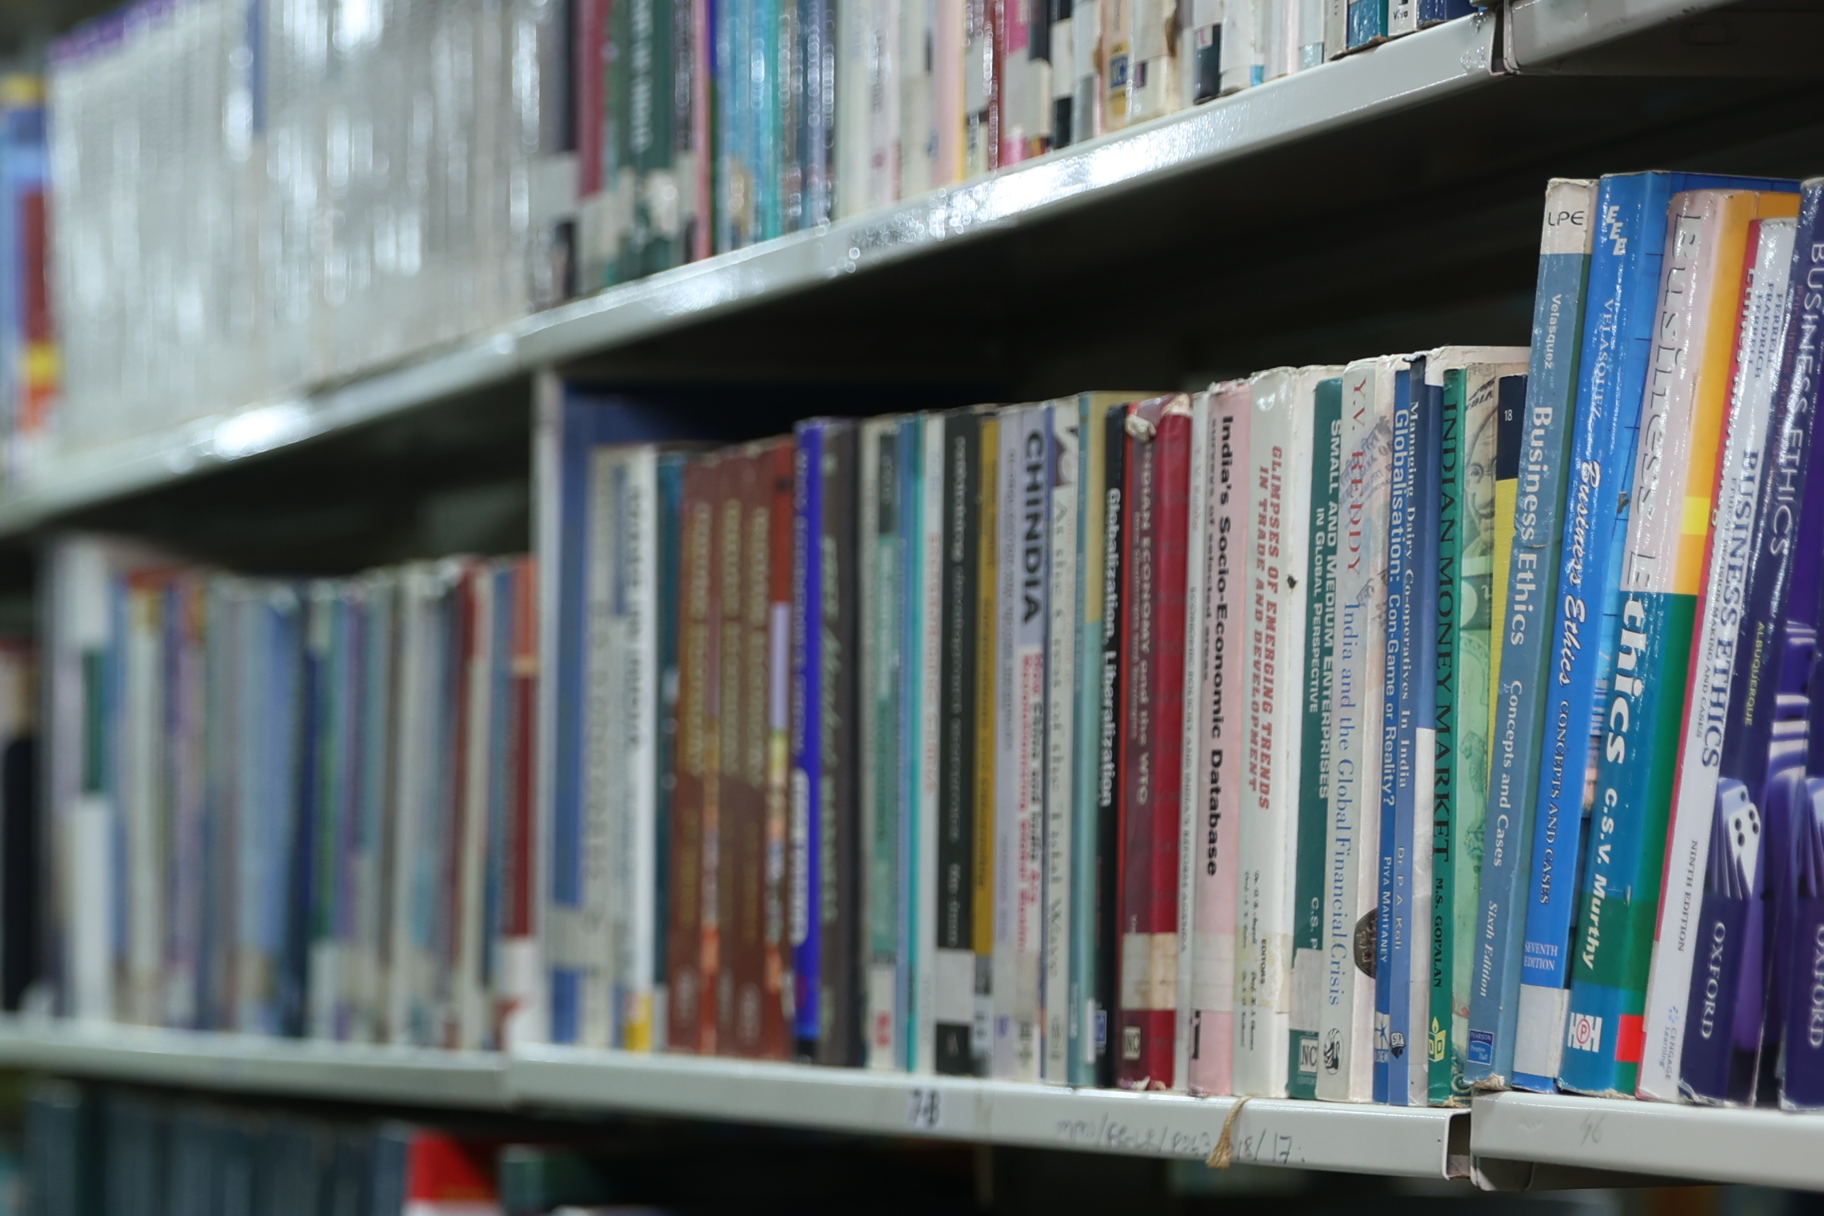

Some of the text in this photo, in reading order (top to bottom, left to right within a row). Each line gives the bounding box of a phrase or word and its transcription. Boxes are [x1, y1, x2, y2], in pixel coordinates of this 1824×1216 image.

[1547, 210, 1585, 227] LPE
[1542, 293, 1563, 369] Velasquez
[1592, 298, 1615, 420] VELASQUEZ
[1346, 378, 1367, 577] Y.V. REDDY
[1504, 410, 1513, 422] 18
[1023, 430, 1046, 626] CHINDIA
[1398, 401, 1420, 789] Managing Dairy Co-operatives In India
[1206, 415, 1234, 877] India's Socio-Economic Database
[1248, 465, 1270, 793] IN TRADE AND DEVELOPMENT
[1258, 445, 1284, 811] GLIMPSES OF EMERGING TRENDS
[1307, 506, 1325, 715] IN GLOBAL PERSPECTIVE
[1318, 418, 1343, 800] SMALL AND MEDIUM ENTERPRISES
[1382, 408, 1410, 808] Globalisation: Con-Game or Reality?
[1432, 402, 1458, 863] INDIAN MONEY MARKET
[1492, 405, 1553, 868] Business Ethics Concepts and Cases
[1539, 459, 1602, 906] Business Ethics CONCEPTS AND CASES
[1700, 450, 1759, 769] BUSINESS ETHICS
[1745, 621, 1765, 728] ALBUQUERQUE
[1327, 602, 1361, 1007] India and the Global Financial Crisis
[1597, 788, 1617, 865] C.S.V.
[1379, 855, 1393, 964] PIYA MAHTANEY
[1433, 877, 1444, 988] M.S. GOPALAN
[1479, 900, 1499, 998] Sixth Edition
[1524, 942, 1558, 958] SEVENTH
[1524, 956, 1556, 972] EDITION
[1582, 872, 1608, 971] Murthy
[1675, 839, 1700, 954] NINTH EDITION
[1699, 921, 1726, 1040] OXFORD
